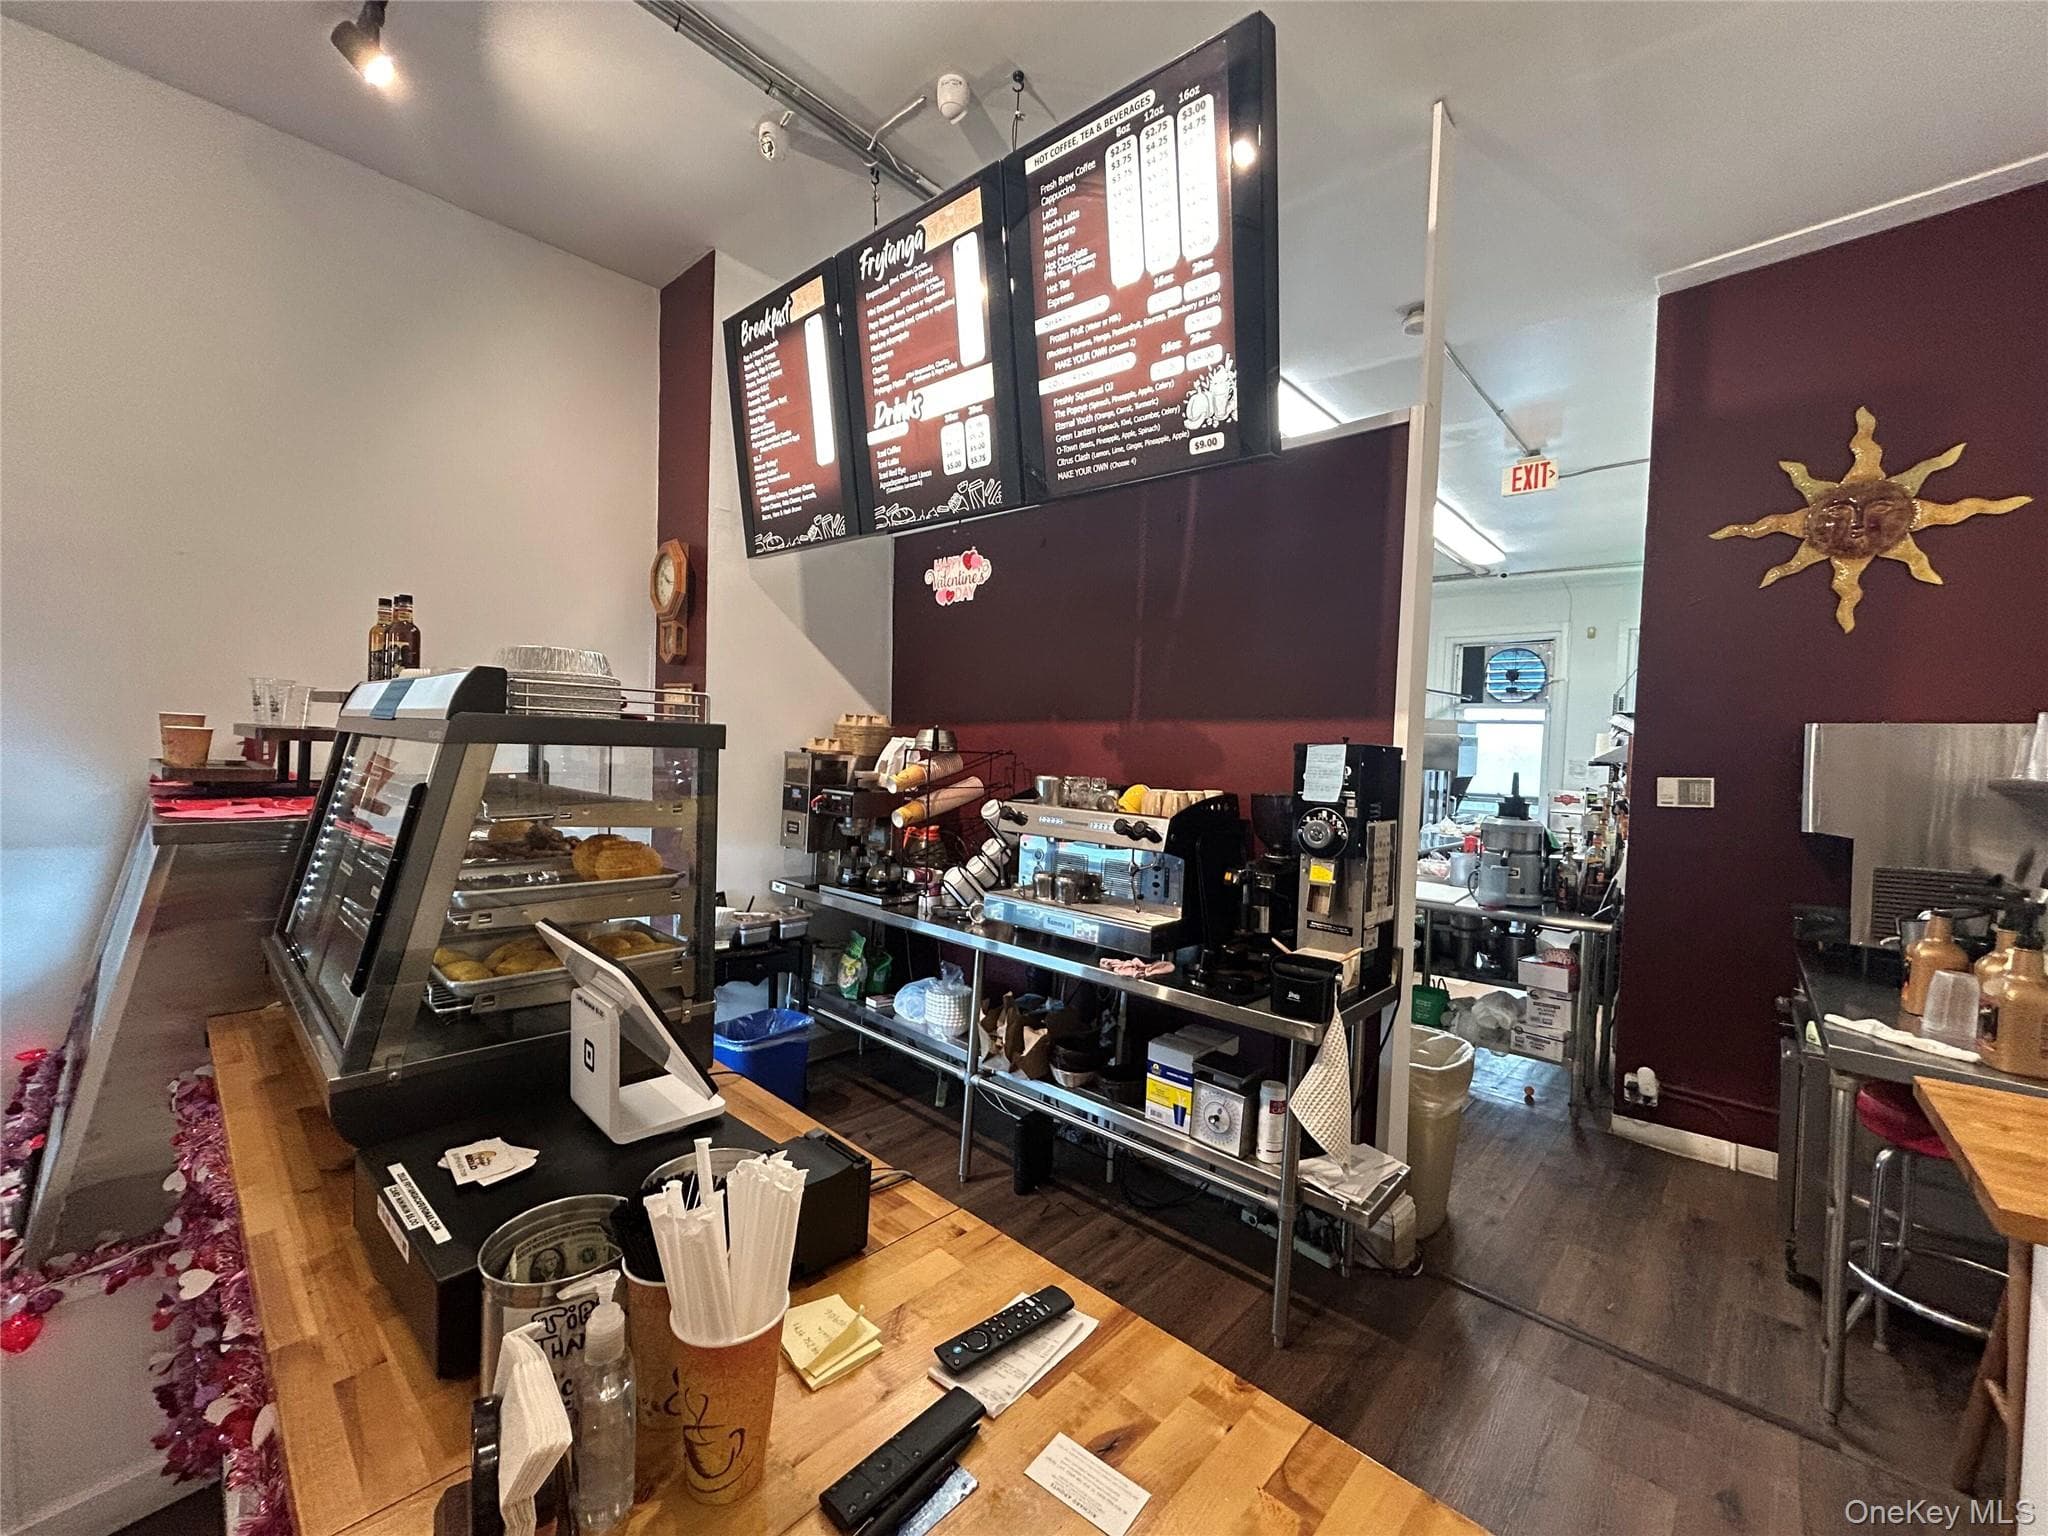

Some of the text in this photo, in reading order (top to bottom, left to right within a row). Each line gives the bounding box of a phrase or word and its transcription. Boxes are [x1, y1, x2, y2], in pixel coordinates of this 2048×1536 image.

[1116, 85, 1200, 137] 8oz 12oz 16oz
[1035, 94, 1151, 166] HOT COFFEE, TEA & BEVERAGES
[1111, 140, 1131, 157] $2.25
[1145, 120, 1167, 139] $2.75
[1182, 100, 1206, 119] $3.00
[1111, 153, 1131, 170] $3.75
[1146, 135, 1167, 152] $4.25
[1183, 115, 1206, 134] $4.75
[1041, 160, 1096, 195] Fresh Brew Coffee
[1041, 184, 1076, 206] Cappuccino
[1042, 207, 1057, 220] Latte
[1044, 226, 1075, 246] Americano
[859, 228, 923, 282] Frytanga
[1045, 243, 1069, 260] Red Eye
[1048, 292, 1074, 309] Espresso
[741, 296, 791, 347] Breakfast
[1050, 332, 1069, 344] Frozen
[1070, 325, 1084, 337] Fruit
[1055, 358, 1071, 370] MAKE
[1072, 352, 1090, 364] YOUR
[1091, 346, 1107, 358] OWN
[874, 391, 923, 429] Drinks
[1056, 433, 1073, 443] Green
[1074, 427, 1096, 438] Lantern
[1057, 457, 1073, 466] Citrus
[1075, 452, 1090, 462] Clash
[1172, 430, 1189, 440] Apple)
[1195, 438, 1217, 450] $9.00
[947, 454, 986, 470] $5.00 $5.75
[1058, 470, 1074, 480] MAKE
[1075, 466, 1092, 476] YOUR
[1093, 462, 1108, 472] OWN
[1511, 462, 1551, 492] EXIT
[925, 563, 987, 591] Valentine's
